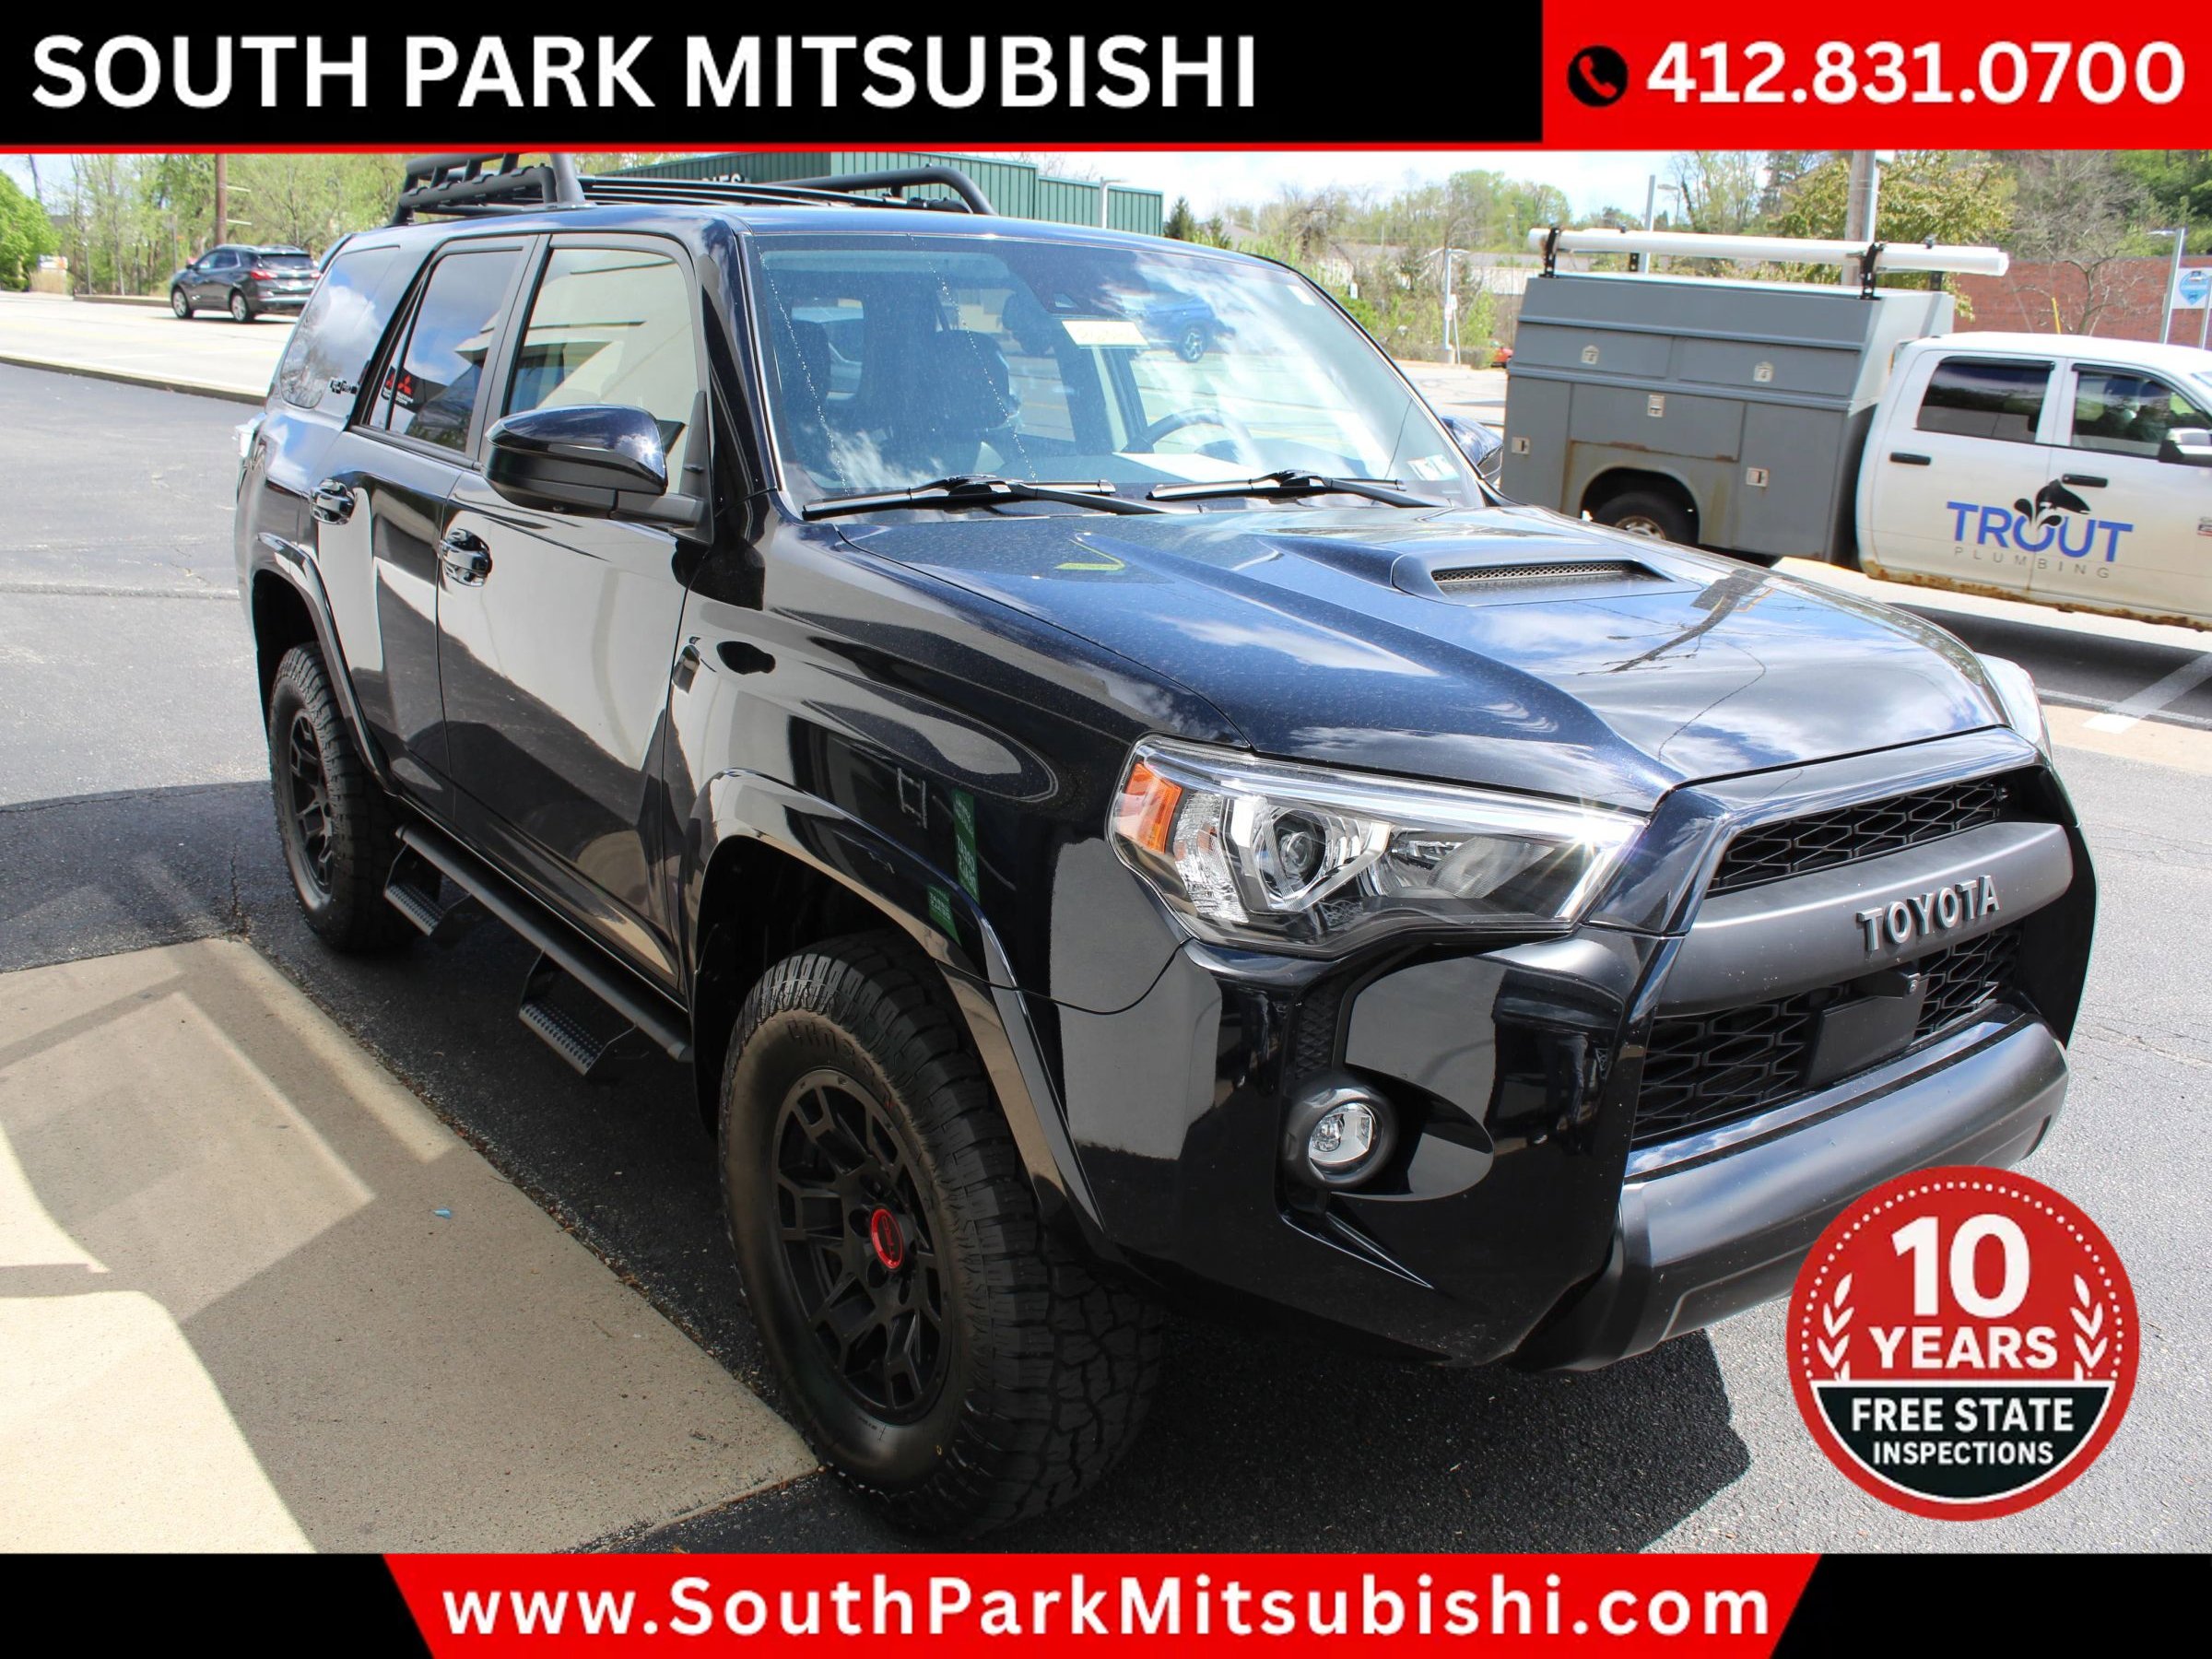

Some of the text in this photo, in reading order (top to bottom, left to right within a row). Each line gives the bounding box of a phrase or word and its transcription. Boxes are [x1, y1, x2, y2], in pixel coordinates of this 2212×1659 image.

[1946, 500, 2135, 562] TROUT
[1954, 547, 2110, 579] PLUMBING
[1856, 875, 2000, 952] TOYOTA
